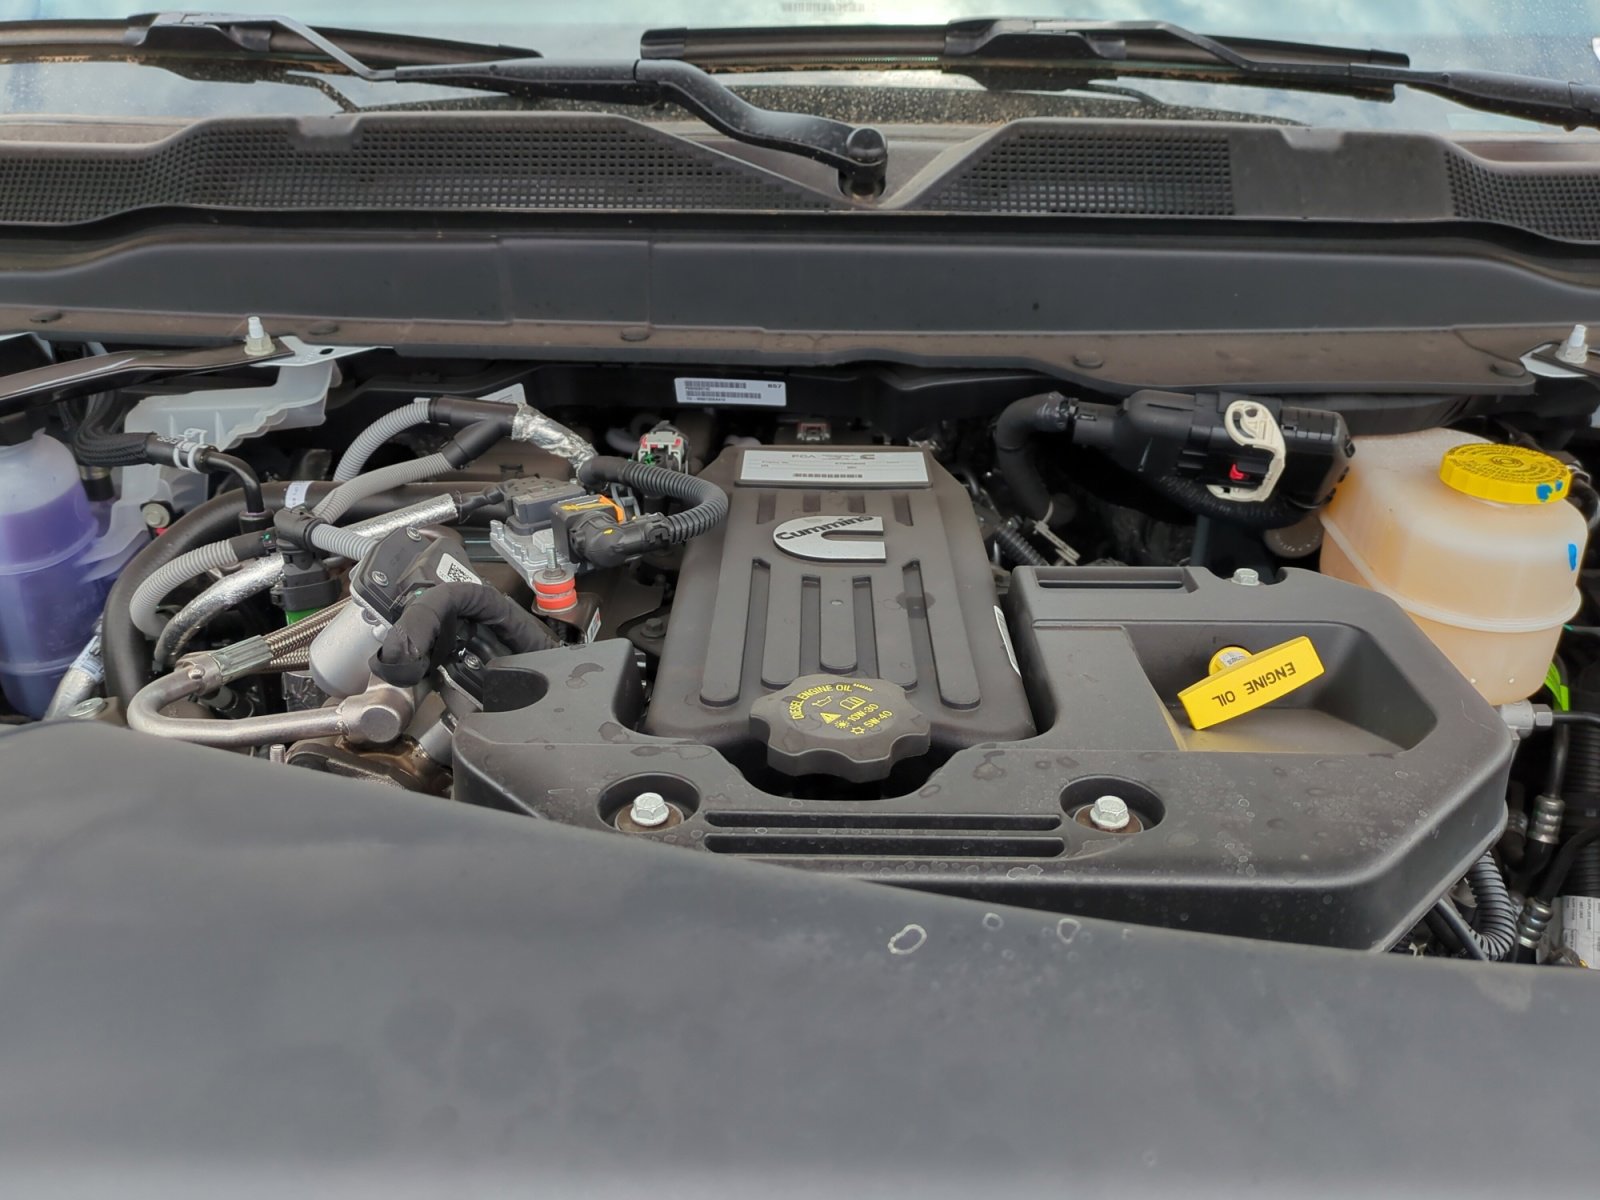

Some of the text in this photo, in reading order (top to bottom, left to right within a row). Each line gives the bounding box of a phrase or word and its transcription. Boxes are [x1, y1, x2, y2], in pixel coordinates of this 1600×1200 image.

[775, 516, 874, 540] Cummins
[796, 684, 833, 700] ENGINE
[835, 684, 853, 692] OIL
[1211, 661, 1297, 707] ENGINE OIL
[789, 700, 805, 720] DIESEL
[847, 703, 879, 722] 10W-30
[863, 710, 893, 728] 5W-40
